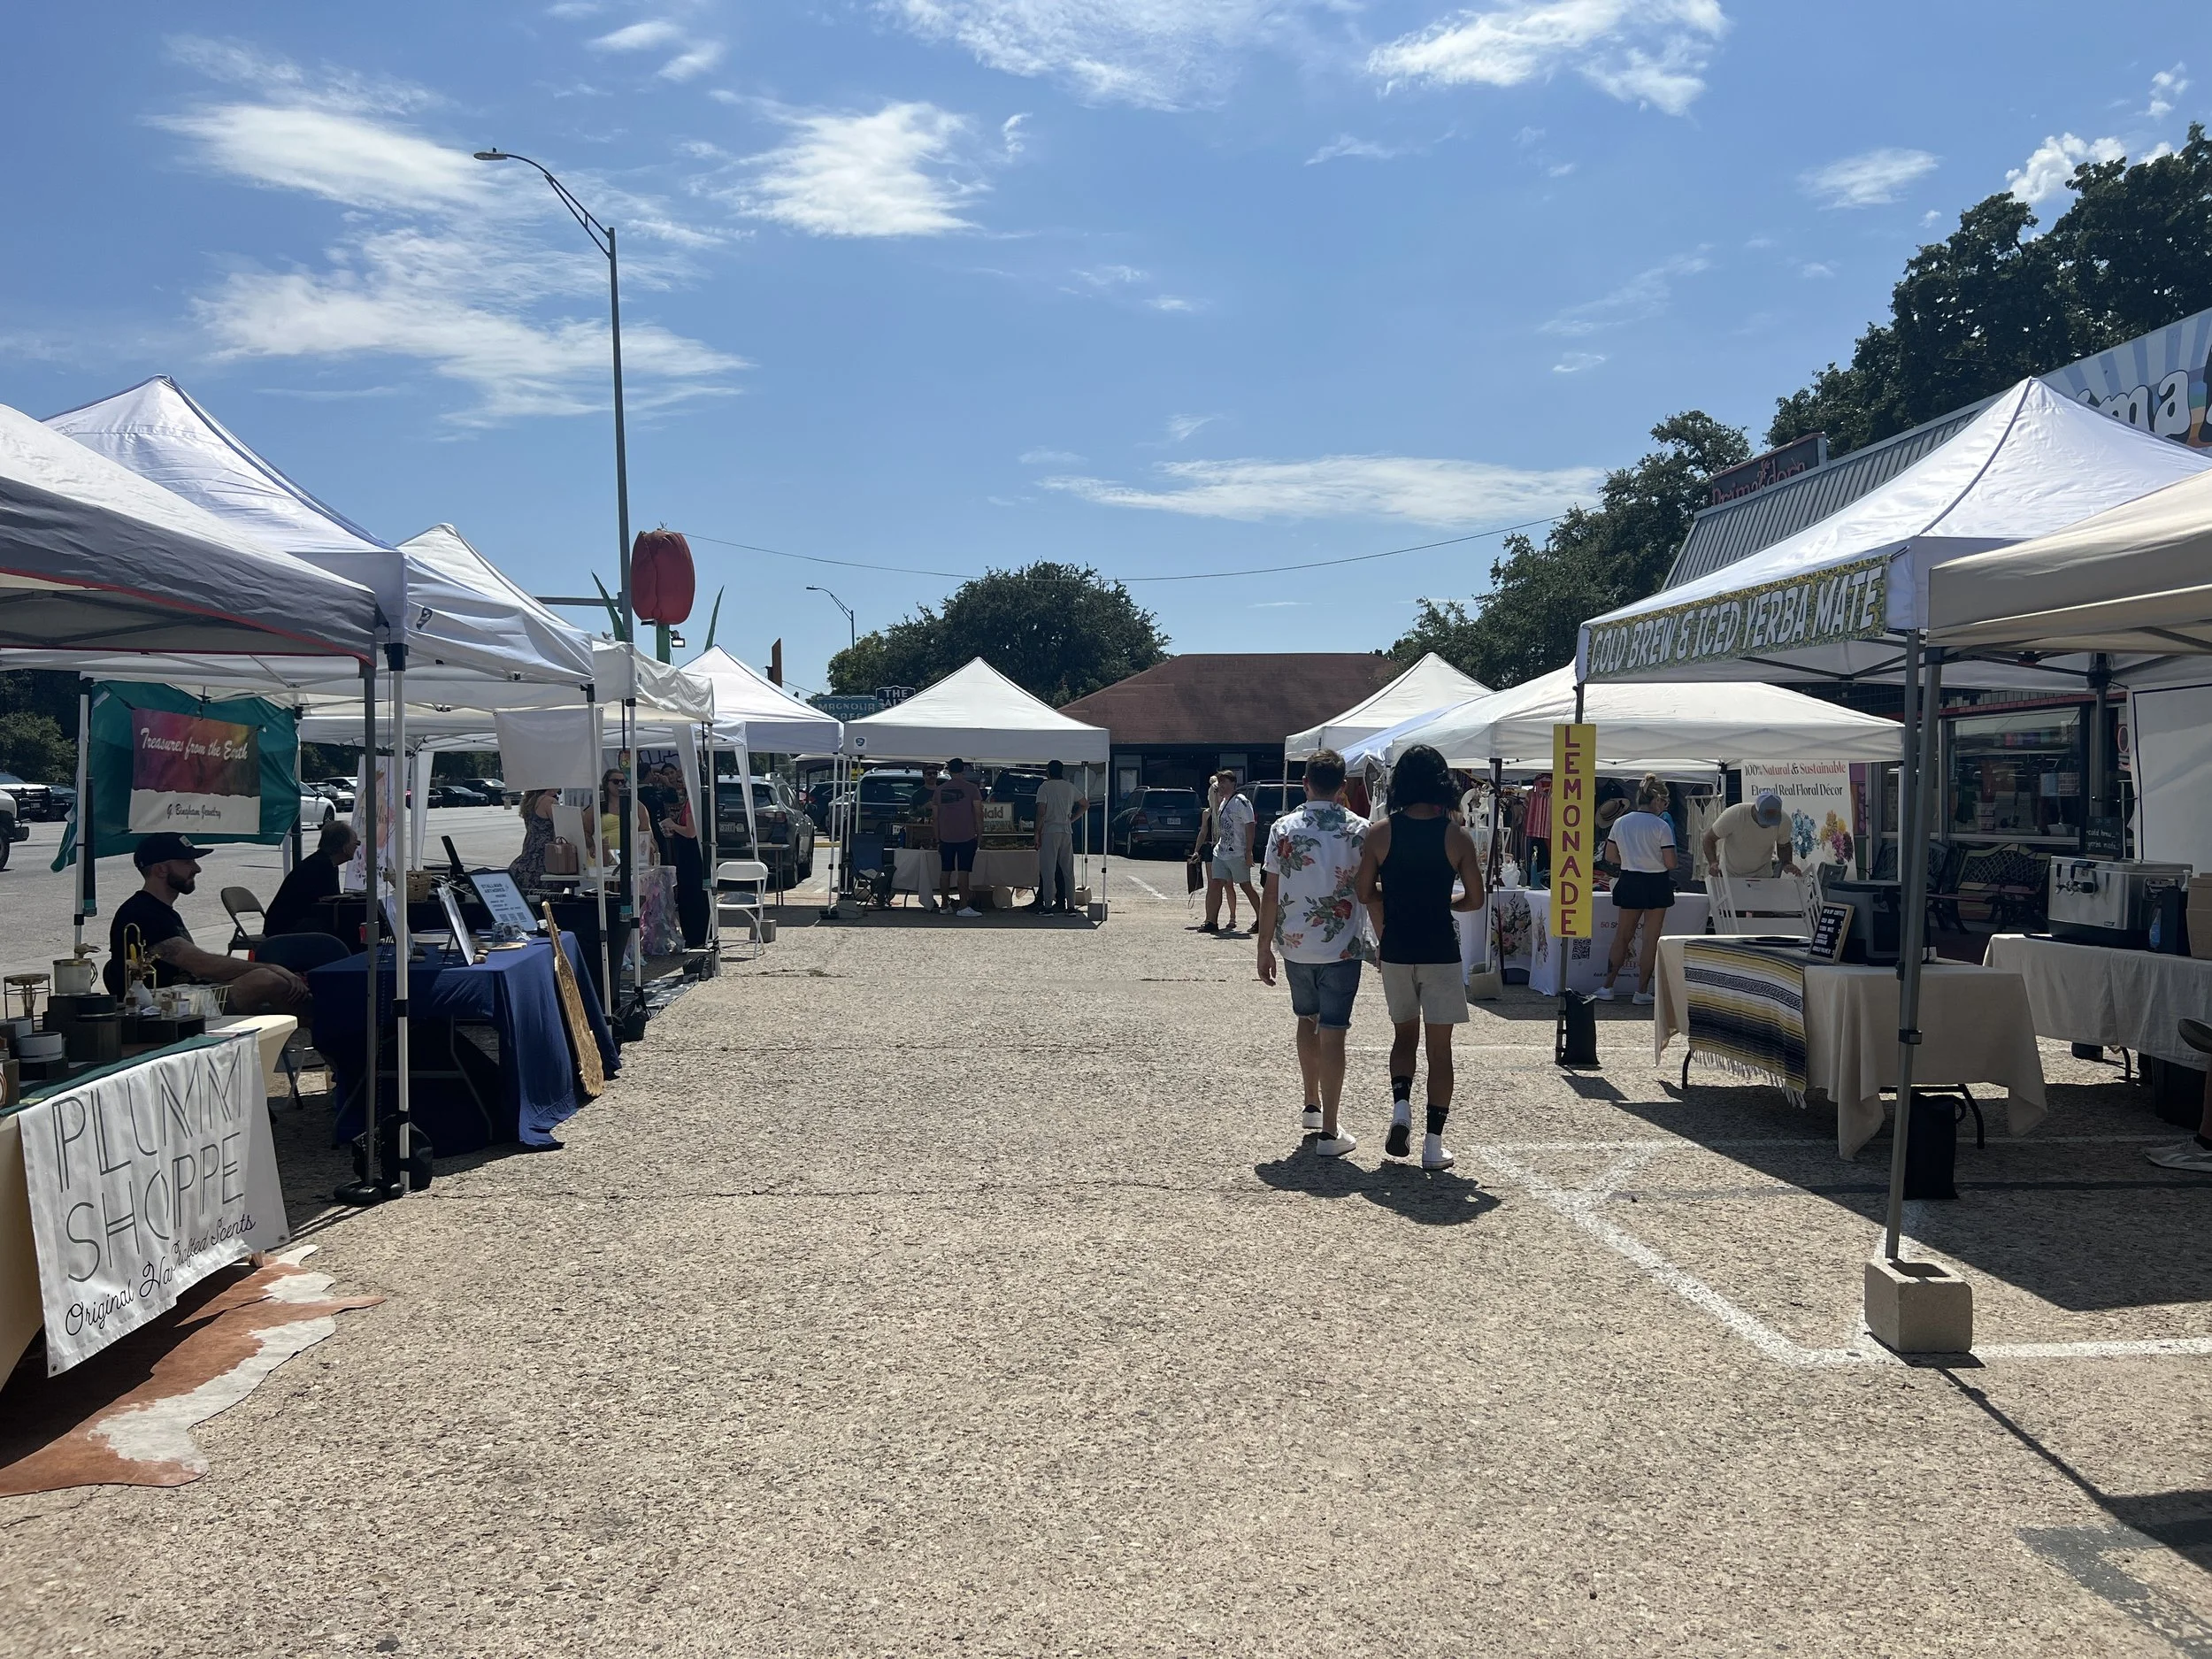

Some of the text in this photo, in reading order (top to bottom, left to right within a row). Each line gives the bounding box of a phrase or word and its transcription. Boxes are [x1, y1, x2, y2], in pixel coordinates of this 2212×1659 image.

[1591, 565, 1883, 674] COLD BREW & ICED YERBA MATE
[818, 703, 875, 712] MAGNOLIA
[884, 689, 908, 698] THE
[140, 727, 249, 760] Treasures from the Earth
[1745, 760, 1847, 776] 100% Natural & Sustainable
[1778, 783, 1796, 796] Real
[1796, 783, 1819, 795] Floral
[1819, 783, 1843, 796] Décor
[1559, 725, 1582, 936] LEMONADE
[51, 1045, 242, 1193] PLUMM
[66, 1132, 244, 1282] SHOPPE
[65, 1279, 134, 1336] Original
[211, 1214, 256, 1245] Scents
